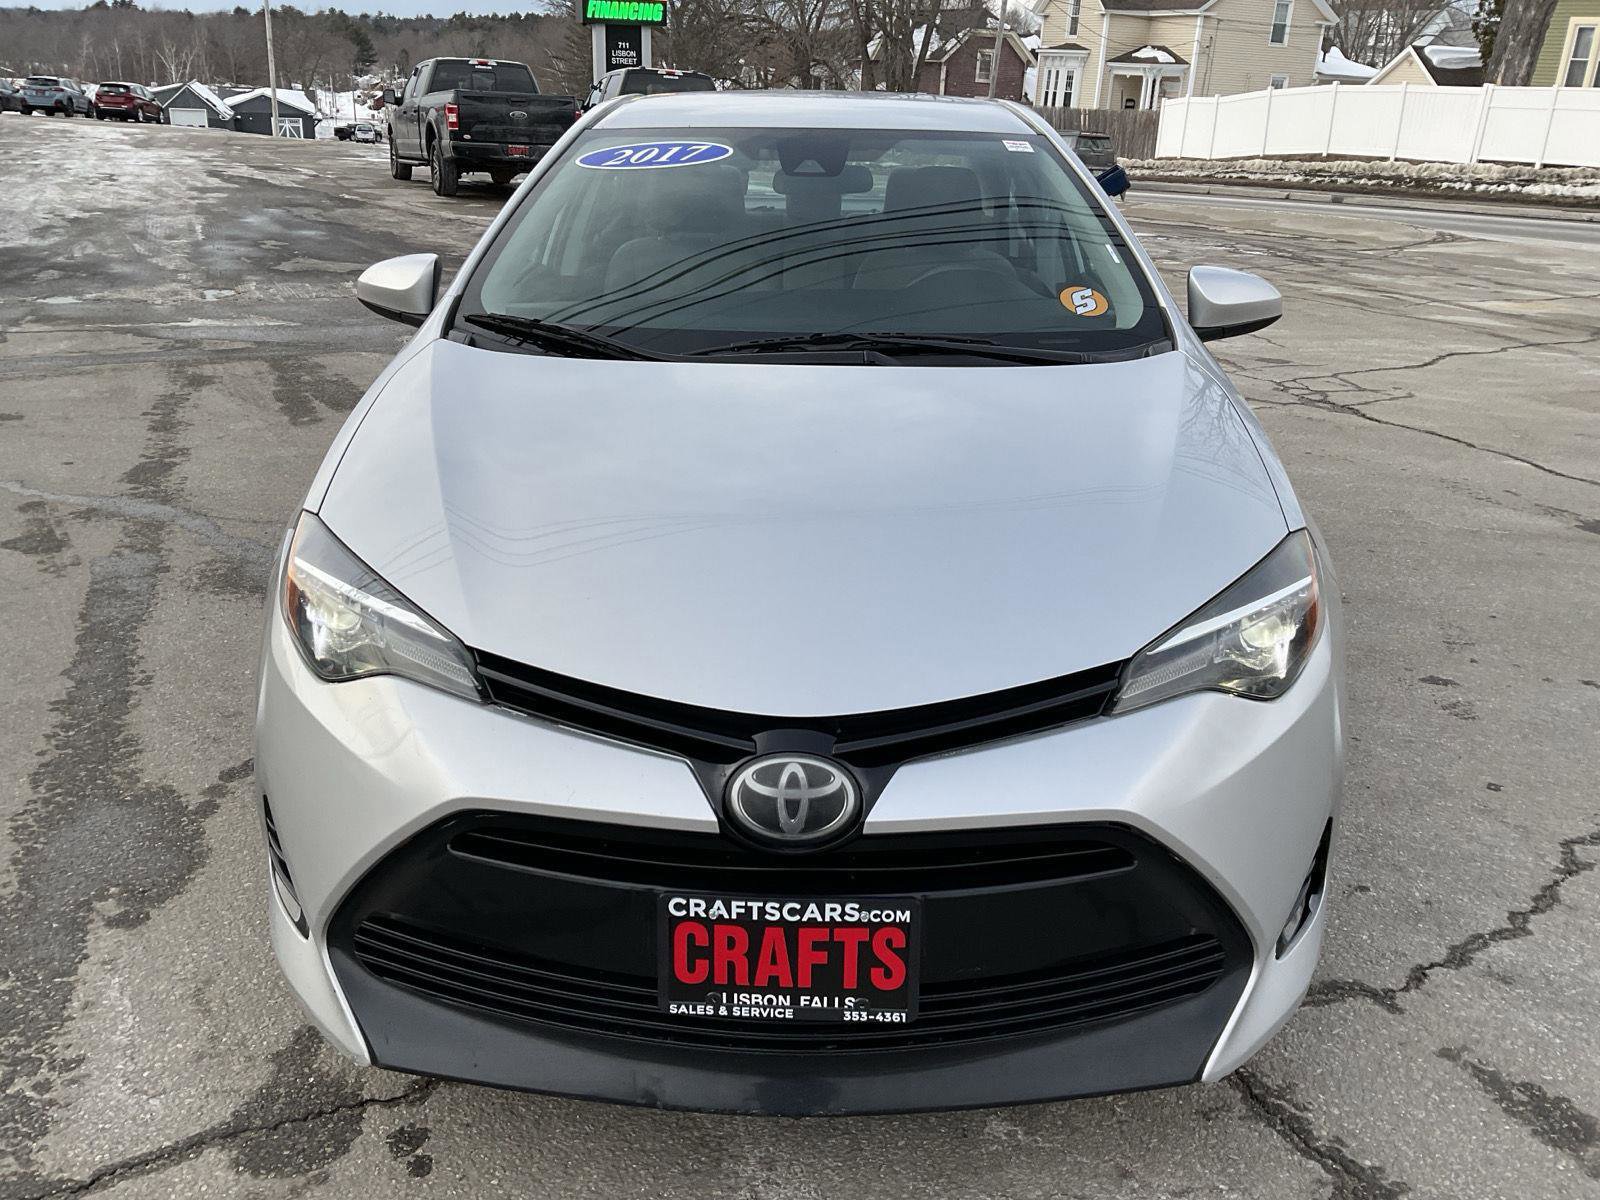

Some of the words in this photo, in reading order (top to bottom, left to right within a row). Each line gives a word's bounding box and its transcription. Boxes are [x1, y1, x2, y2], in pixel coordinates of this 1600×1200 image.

[587, 0, 664, 21] FINANCING
[617, 41, 630, 49] 711
[611, 49, 637, 57] LISBON
[611, 57, 638, 65] STREET
[601, 144, 713, 167] 2017
[673, 921, 907, 991] CRAFTS
[669, 1004, 714, 1016] SALES
[718, 1006, 728, 1016] &
[732, 1006, 794, 1019] SERVICE
[843, 1011, 907, 1023] 353-4361
